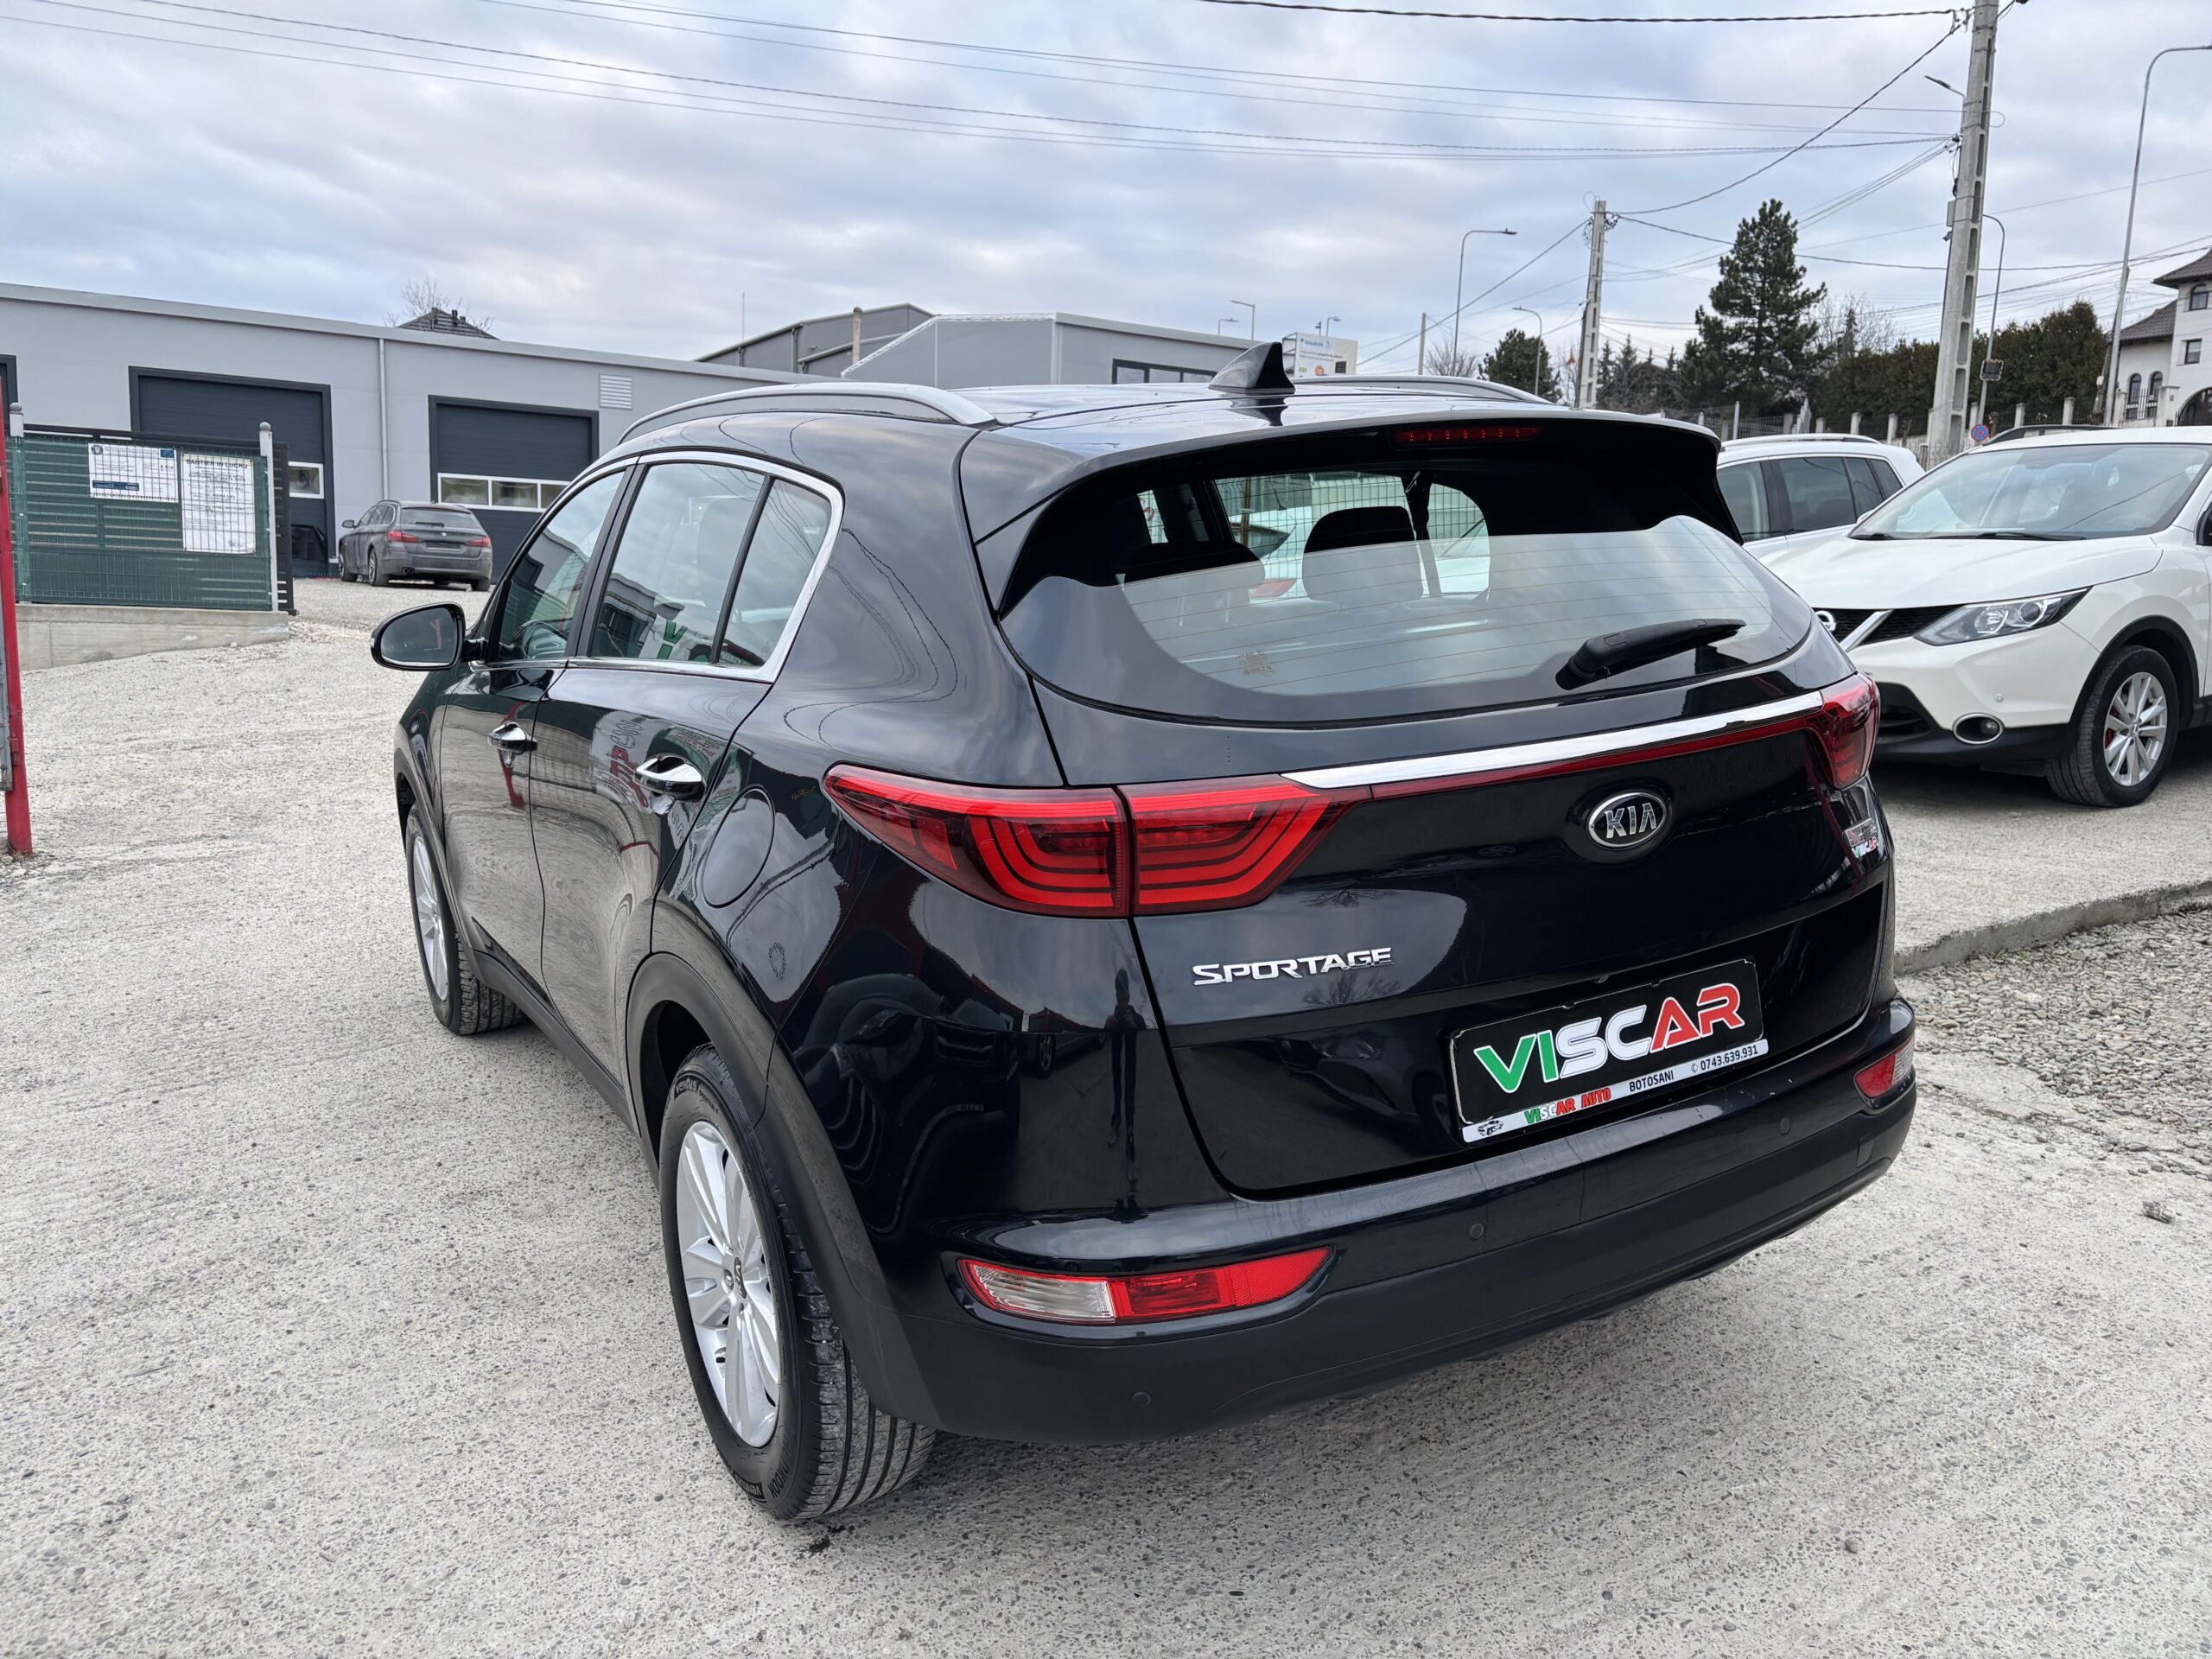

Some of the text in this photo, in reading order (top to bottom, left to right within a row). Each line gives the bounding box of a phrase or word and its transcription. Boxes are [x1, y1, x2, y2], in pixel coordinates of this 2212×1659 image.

[1605, 803, 1656, 838] KIA
[1192, 947, 1395, 986] SPORTAGE
[1473, 982, 1745, 1093] VISCAR
[1524, 1045, 1758, 1124] VISCAR AUTO BOTOSANI 0743.639.931
